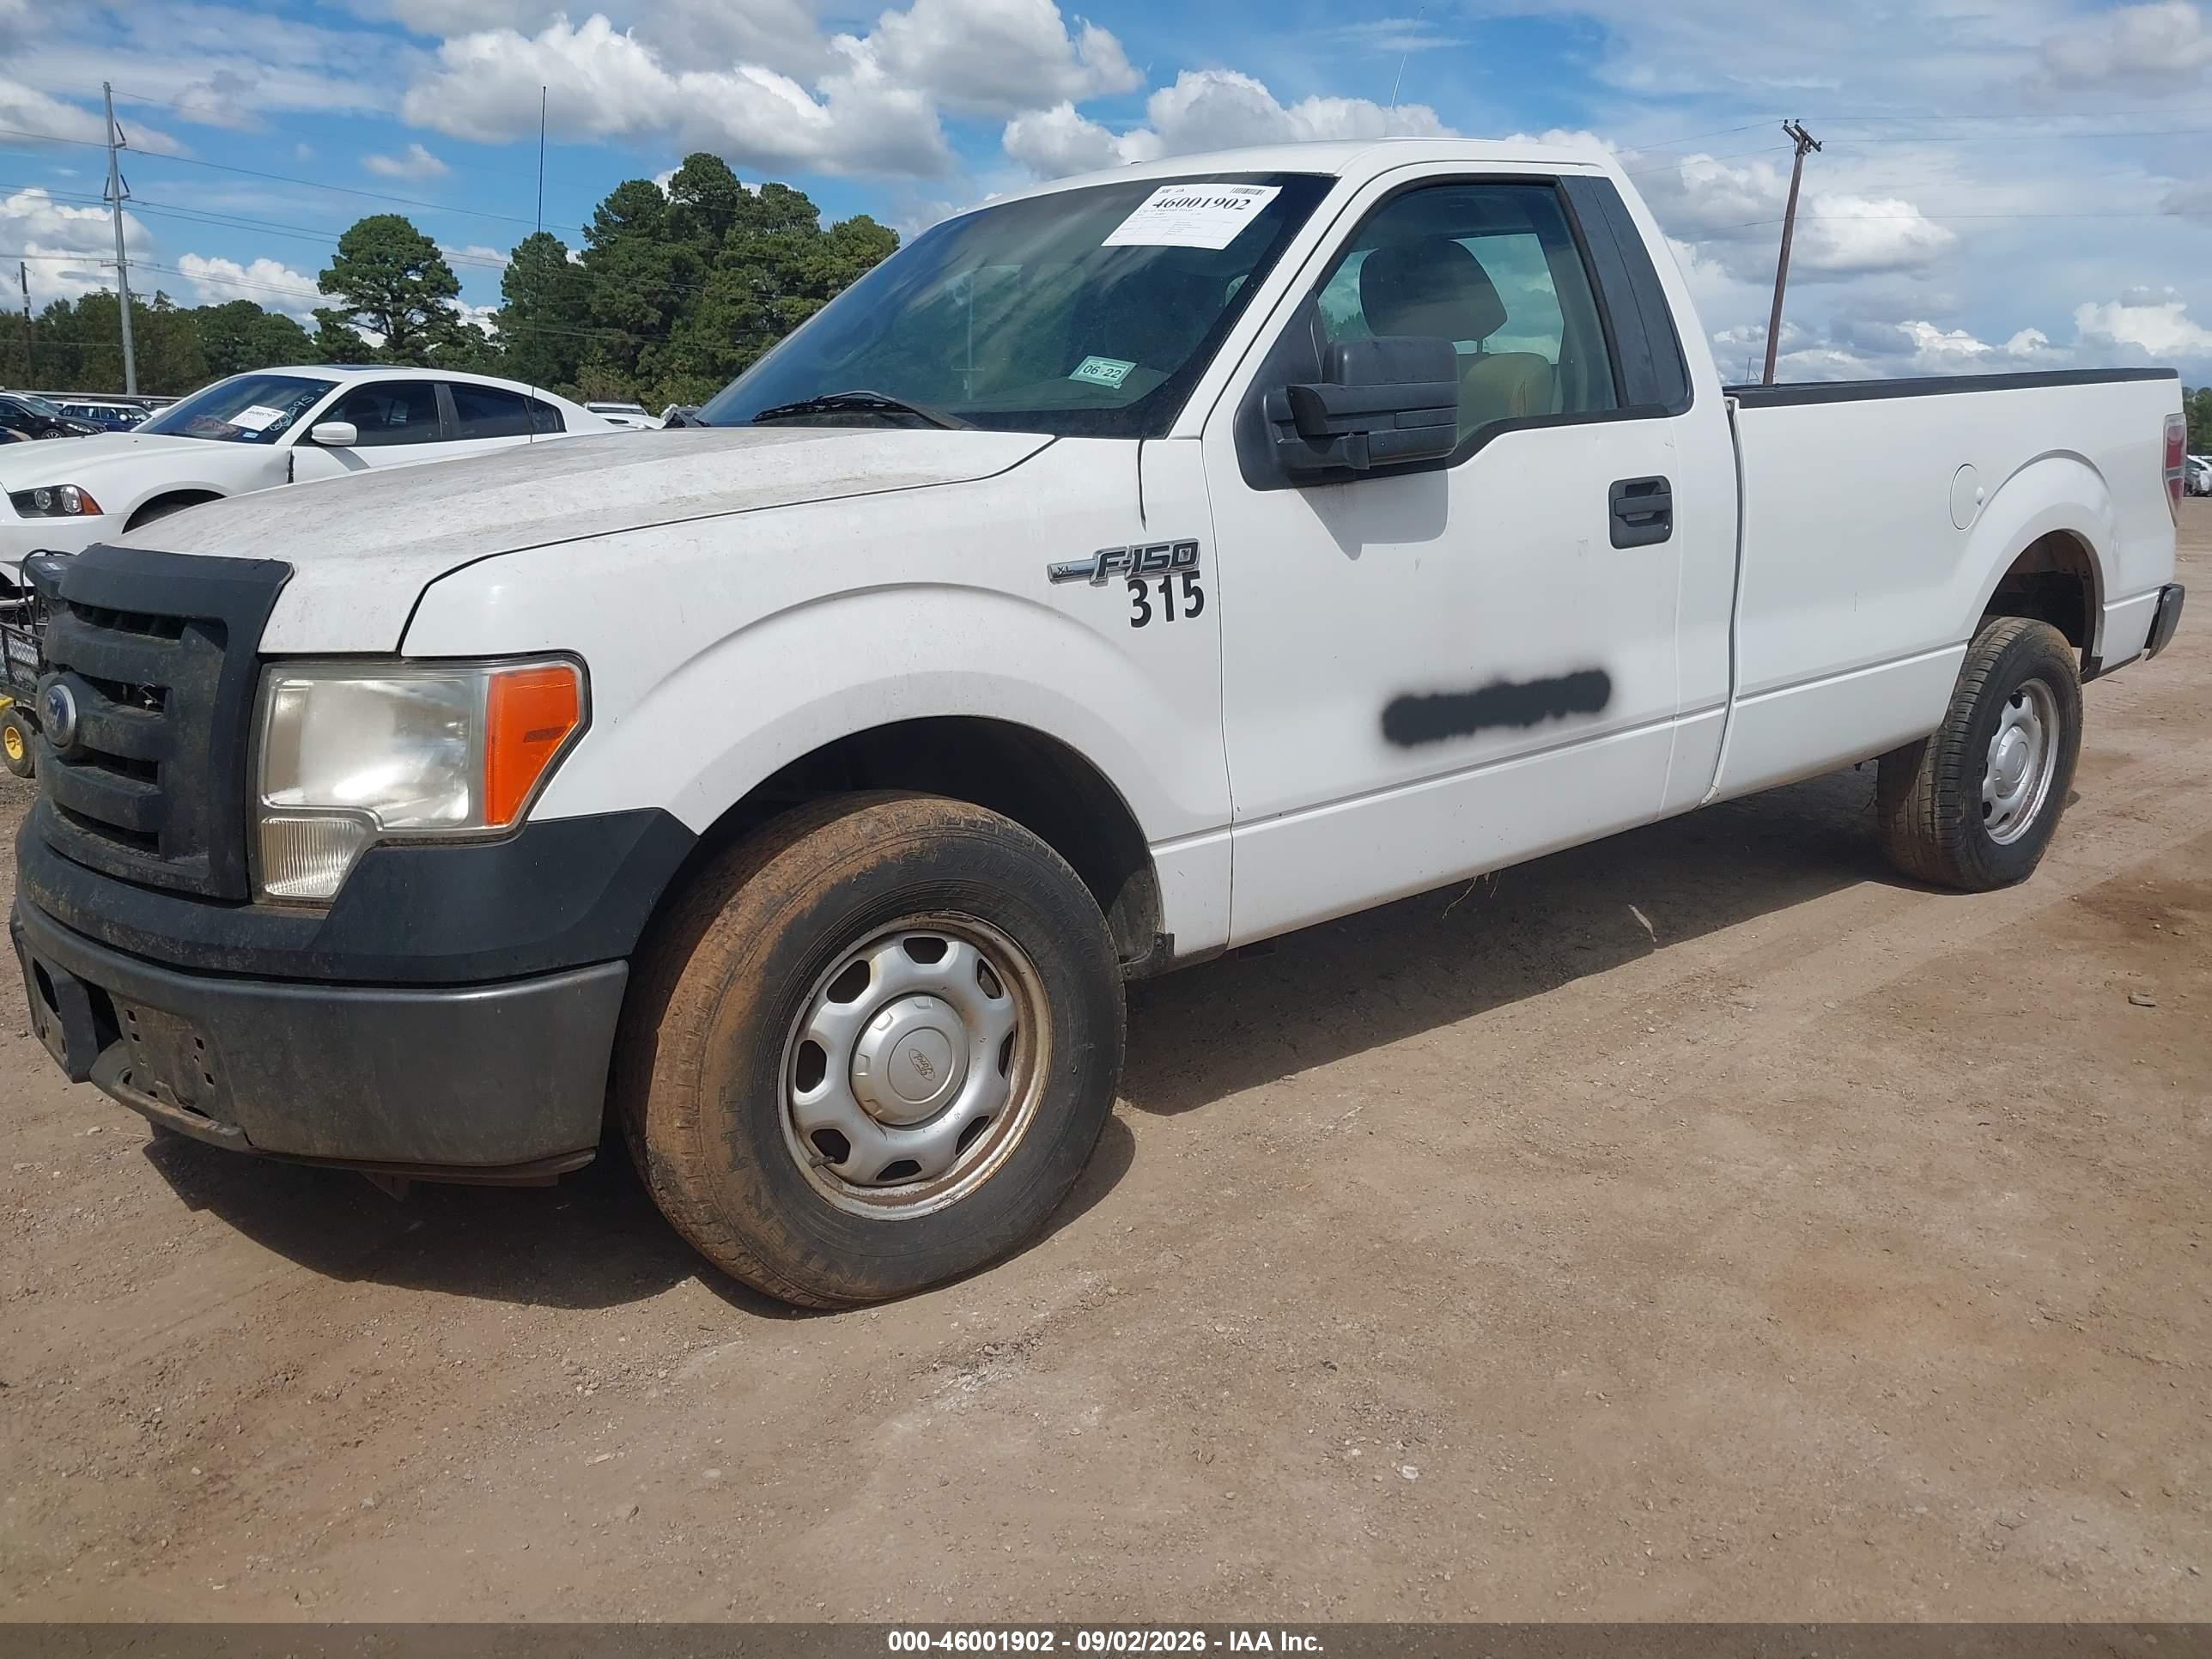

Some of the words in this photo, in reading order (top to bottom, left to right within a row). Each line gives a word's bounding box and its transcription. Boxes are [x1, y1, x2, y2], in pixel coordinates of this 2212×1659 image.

[1152, 196, 1251, 211] 46001902
[1082, 364, 1101, 375] 06
[1103, 368, 1122, 379] 22
[1056, 564, 1073, 575] XL
[1091, 538, 1200, 585] F-150
[1127, 569, 1205, 629] 315
[898, 848, 1102, 975] SUMITOMO
[913, 1052, 934, 1077] Ford
